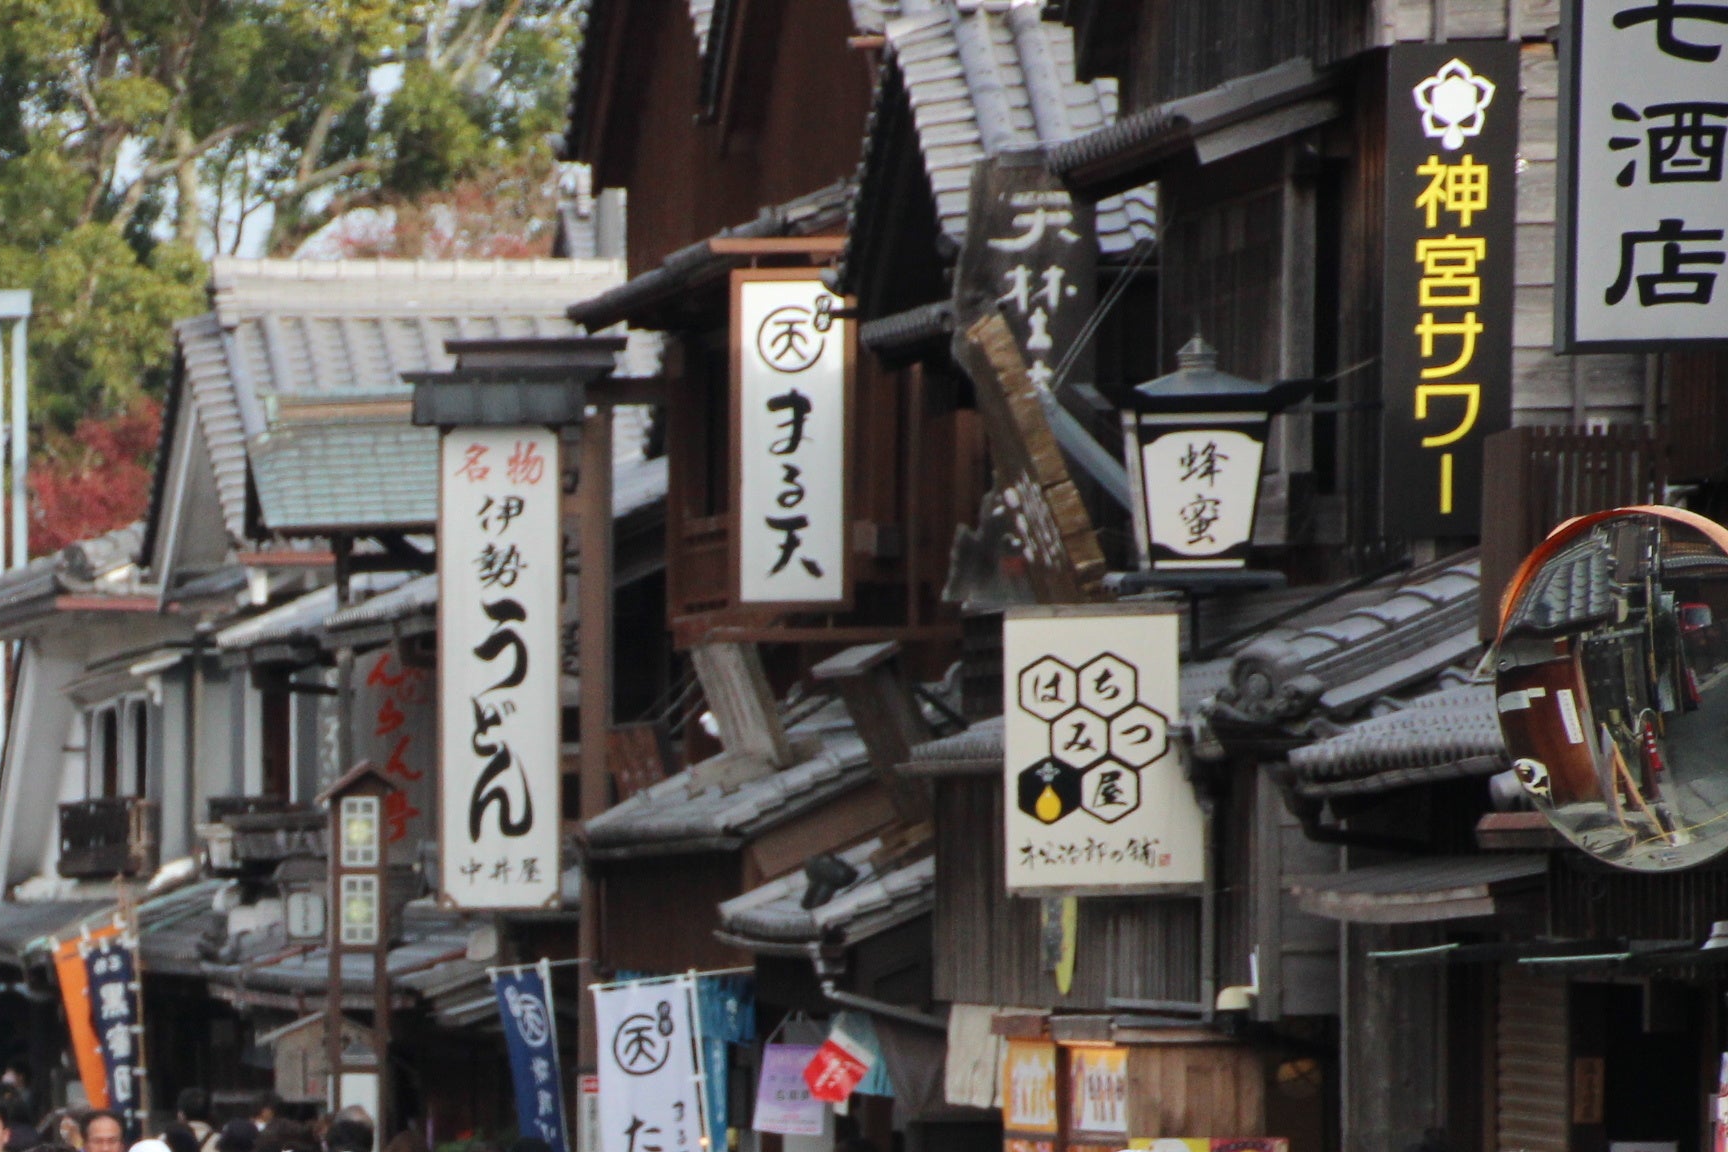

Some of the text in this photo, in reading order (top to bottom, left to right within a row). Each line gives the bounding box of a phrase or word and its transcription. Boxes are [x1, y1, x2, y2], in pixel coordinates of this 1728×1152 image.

[1414, 154, 1488, 514] 神宮サワー
[454, 441, 545, 485] 名物
[765, 388, 825, 578] まる天
[1180, 441, 1230, 545] 蜂蜜
[470, 494, 534, 844] 伊勢うどん
[459, 856, 544, 887] 中井屋
